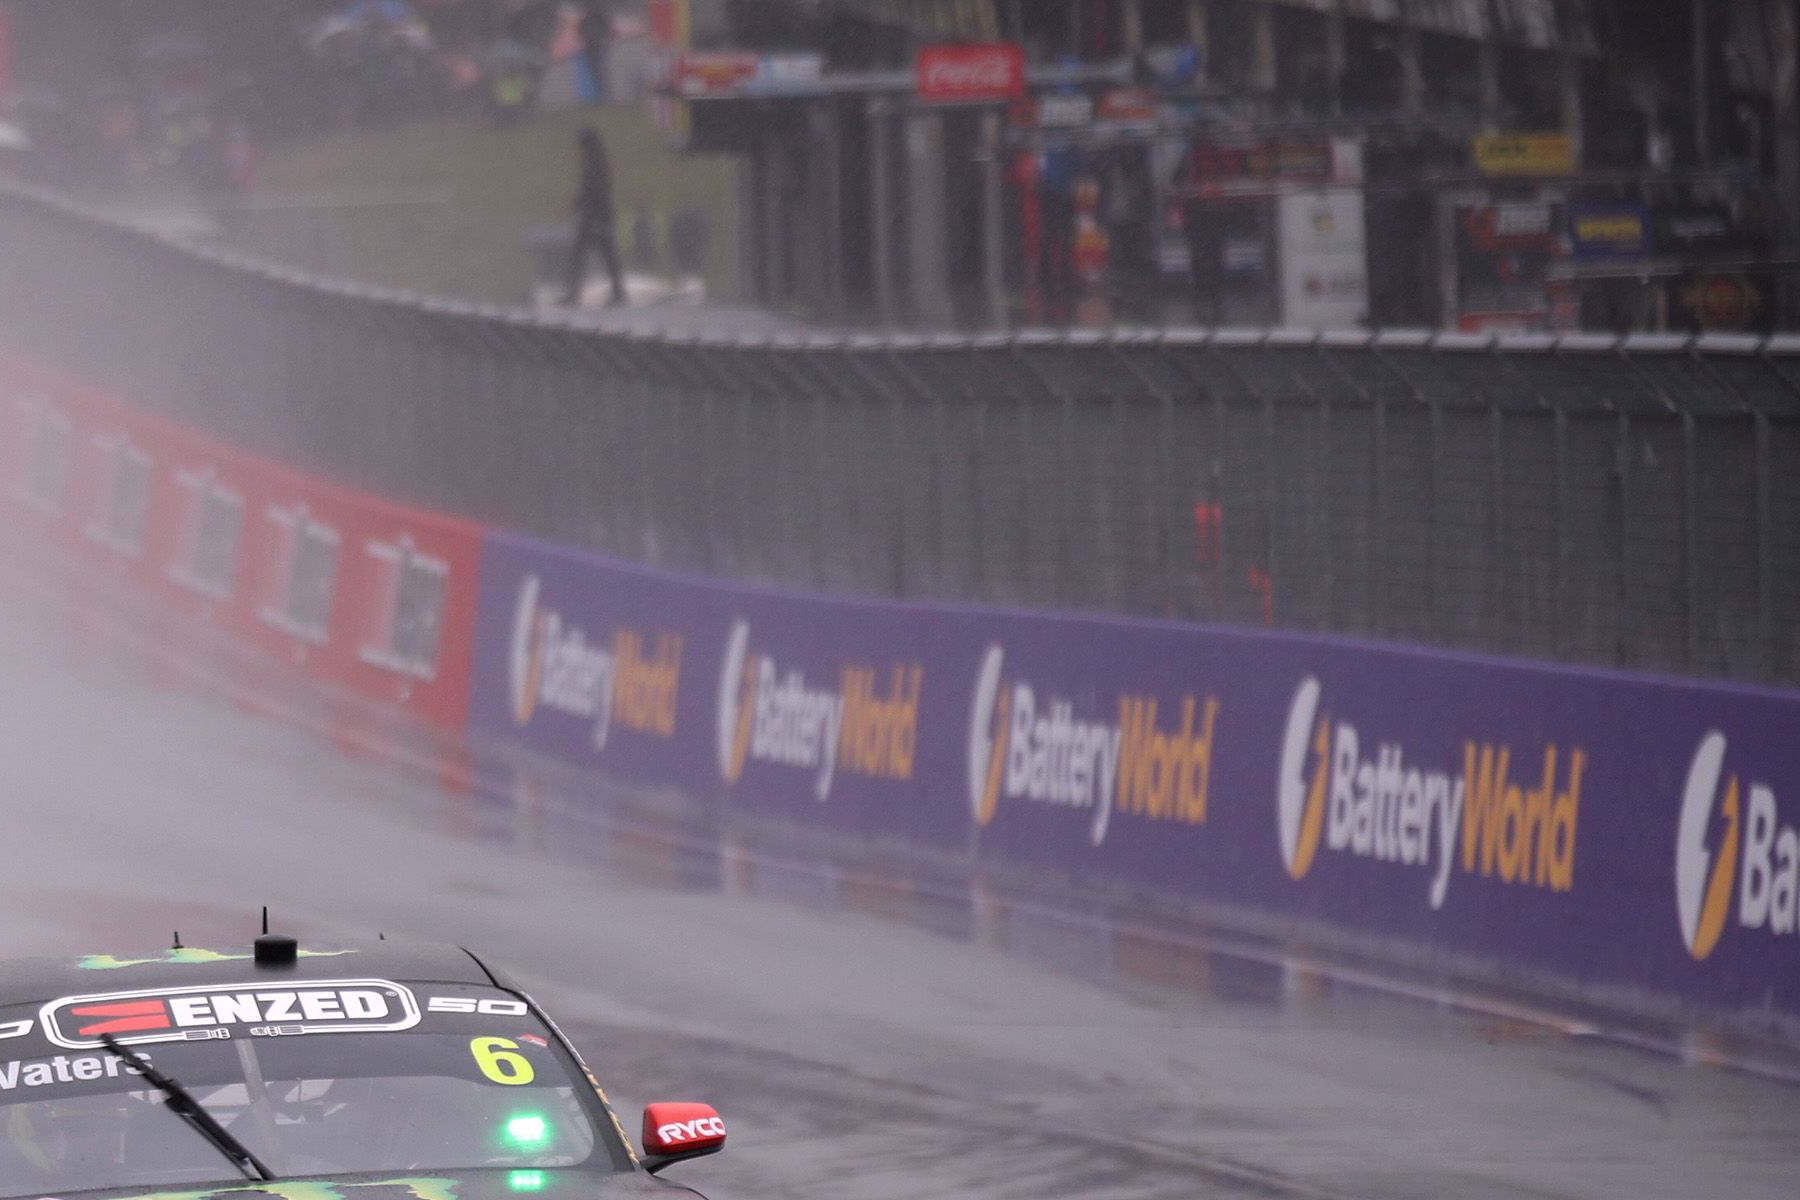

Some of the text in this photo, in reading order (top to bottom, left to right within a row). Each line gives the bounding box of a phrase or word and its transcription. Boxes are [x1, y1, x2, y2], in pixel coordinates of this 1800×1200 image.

[1740, 783, 1800, 936] Ba
[169, 990, 389, 1027] ENZED
[470, 1036, 535, 1086] 6
[657, 1117, 727, 1143] RYCO
